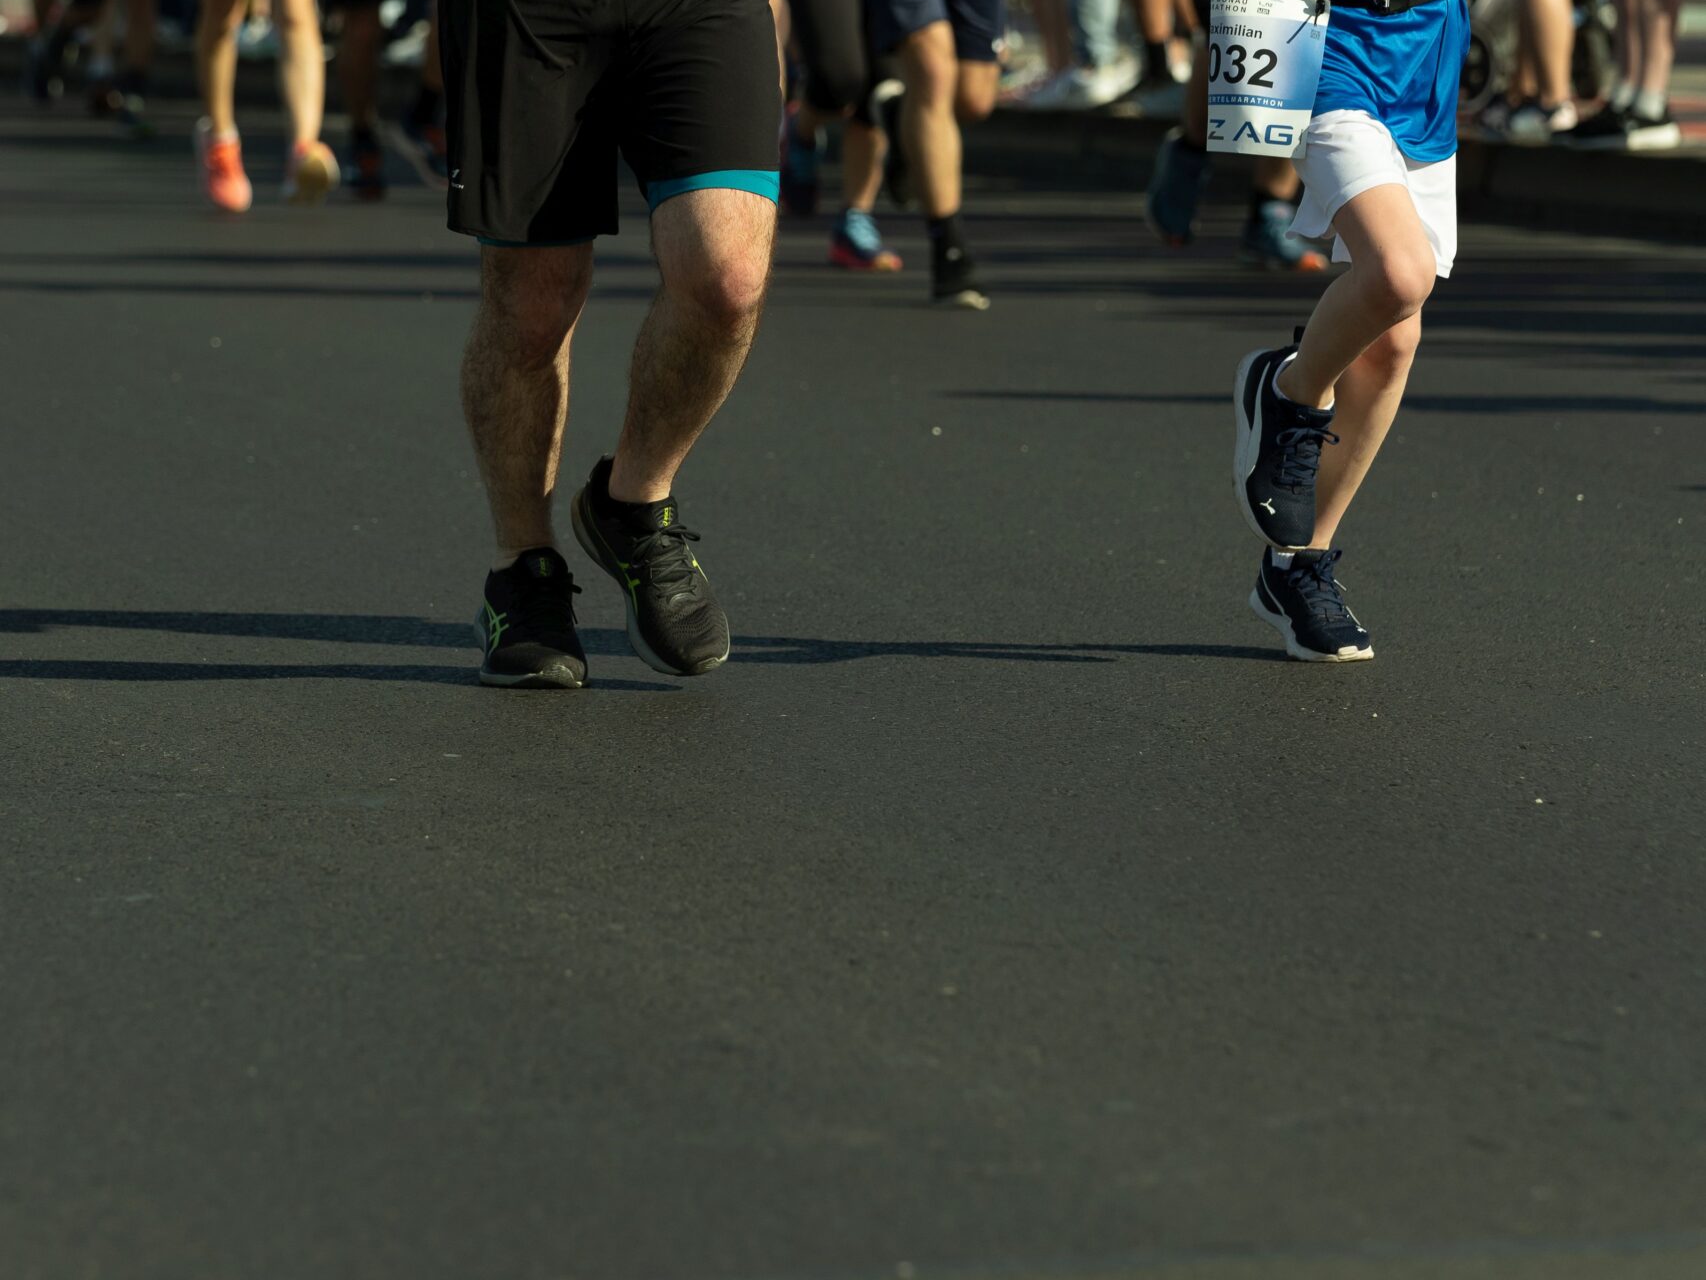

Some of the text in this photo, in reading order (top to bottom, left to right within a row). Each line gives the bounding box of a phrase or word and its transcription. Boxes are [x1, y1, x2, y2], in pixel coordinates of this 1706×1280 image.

[1212, 3, 1247, 13] ATHON
[1210, 23, 1263, 39] aximilian
[1209, 42, 1278, 89] 032
[1232, 121, 1294, 146] AG
